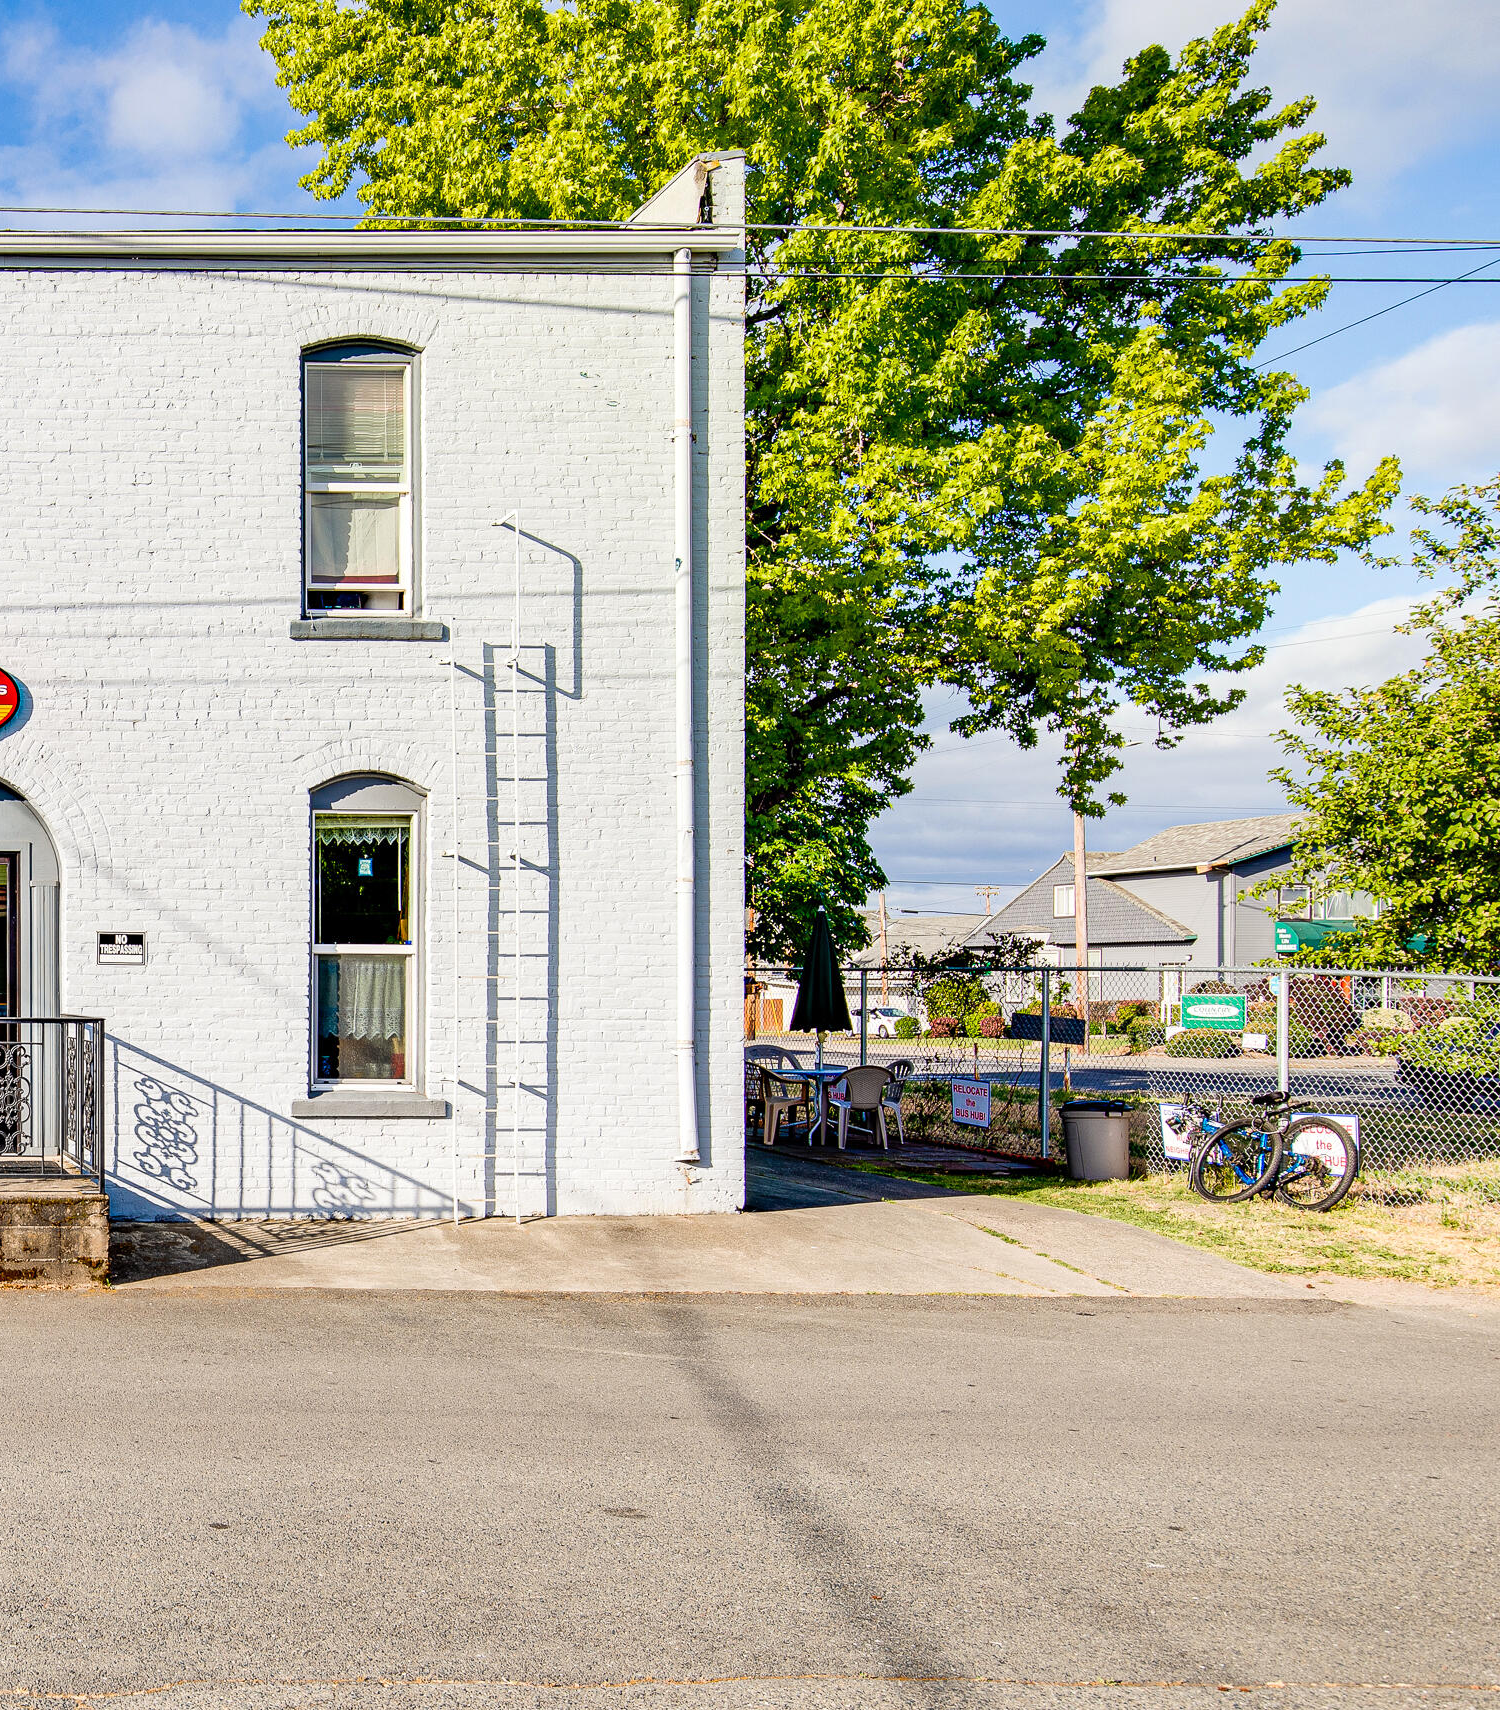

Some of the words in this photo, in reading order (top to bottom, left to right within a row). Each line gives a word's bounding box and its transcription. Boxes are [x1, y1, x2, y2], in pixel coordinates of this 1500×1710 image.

[115, 934, 128, 945] NO
[100, 944, 143, 955] TRESPASSING
[953, 1084, 988, 1097] RELOCATE
[965, 1098, 976, 1107] the
[955, 1108, 969, 1118] BUS
[970, 1110, 986, 1121] HUB!
[1316, 1139, 1333, 1150] the
